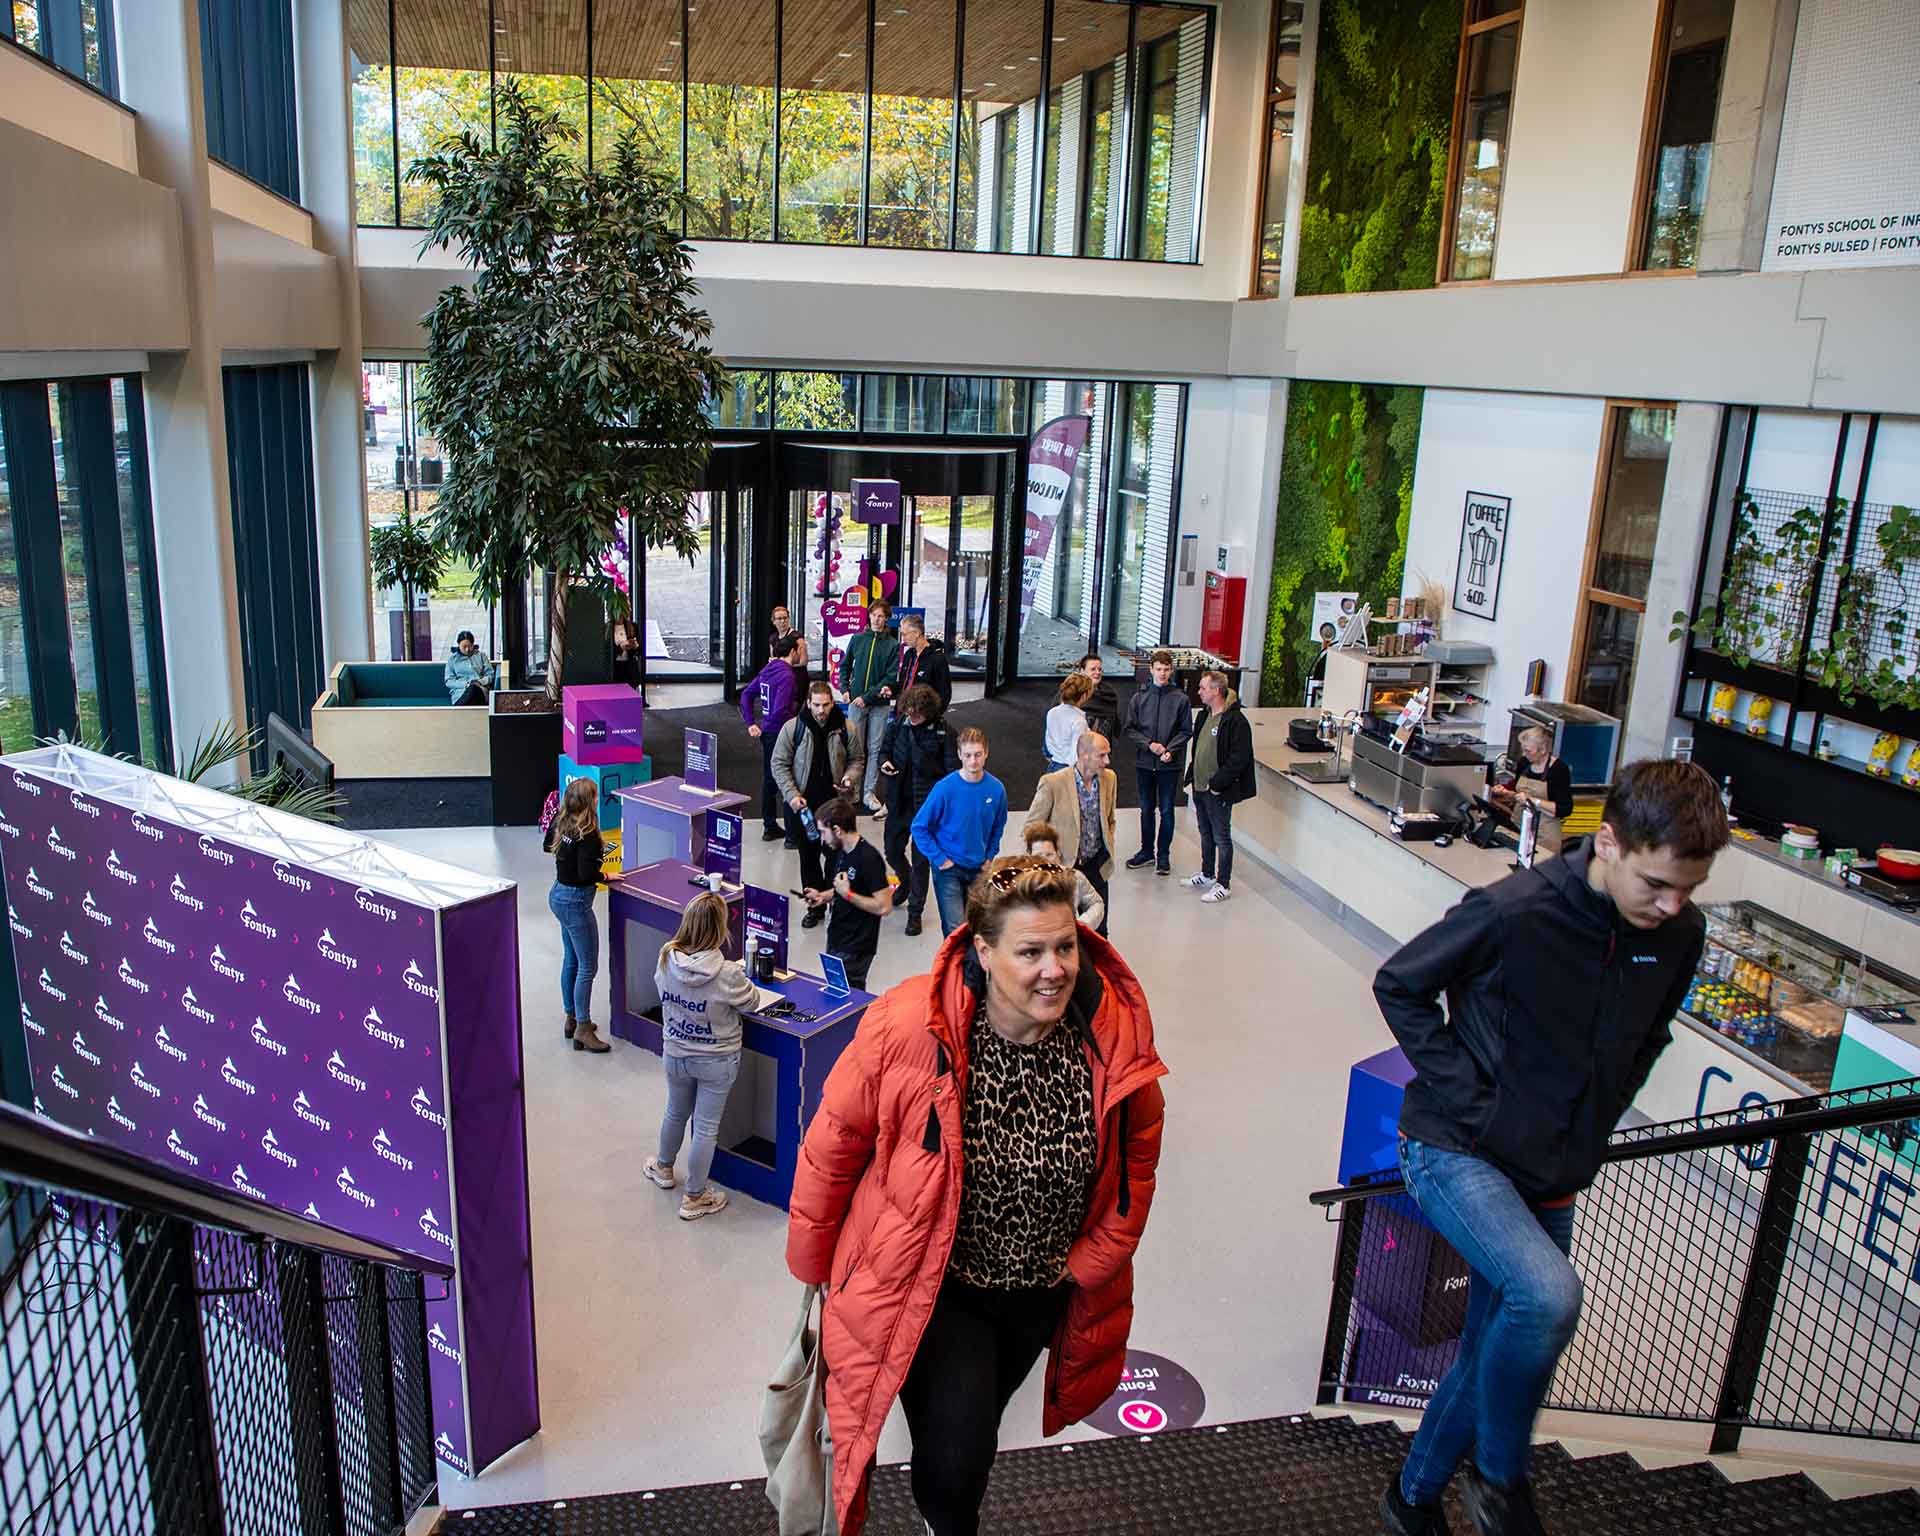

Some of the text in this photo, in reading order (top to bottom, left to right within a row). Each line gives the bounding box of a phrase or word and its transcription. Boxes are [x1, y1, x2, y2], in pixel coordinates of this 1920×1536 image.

[1780, 223, 1824, 237] FONTYS
[1827, 218, 1876, 233] SCHOOL
[1880, 216, 1899, 229] OF
[1777, 243, 1821, 256] FONTYS
[1824, 239, 1869, 253] PULSED
[867, 499, 893, 510] Fontys
[1467, 503, 1505, 532] COFFEE
[14, 776, 41, 797] Fontys
[71, 799, 101, 819] Fontys
[132, 820, 164, 842] Fontys
[50, 840, 75, 861] Fontys
[201, 843, 234, 866] Fontys
[108, 862, 137, 885] Fontys
[275, 867, 312, 893] Fontys
[28, 880, 53, 901] Fontys
[172, 888, 203, 911] Fontys
[84, 904, 111, 926] Fontys
[356, 894, 397, 923] Fontys
[243, 915, 276, 939] Fontys
[146, 931, 175, 954] Fontys
[62, 944, 88, 965] Fontys
[320, 944, 357, 970] Fontys
[120, 971, 149, 994] Fontys
[212, 959, 244, 983] Fontys
[41, 981, 66, 1001] Fontys
[286, 990, 320, 1014] Fontys
[661, 991, 707, 1013] pulsed
[97, 1009, 124, 1031] Fontys
[184, 1001, 214, 1024] Fontys
[253, 1032, 286, 1056] Fontys
[366, 1023, 404, 1049] Fontys
[75, 1045, 100, 1065] Fontys
[157, 1039, 187, 1062] Fontys
[54, 1077, 78, 1098] Fontys
[132, 1075, 160, 1097] Fontys
[223, 1071, 255, 1095] Fontys
[330, 1066, 366, 1092] Fontys
[109, 1110, 136, 1131] Fontys
[195, 1109, 226, 1132] Fontys
[296, 1106, 330, 1131] Fontys
[169, 1142, 198, 1165] Fontys
[264, 1144, 297, 1168] Fontys
[375, 1144, 413, 1170] Fontys
[340, 1182, 375, 1208] Fontys
